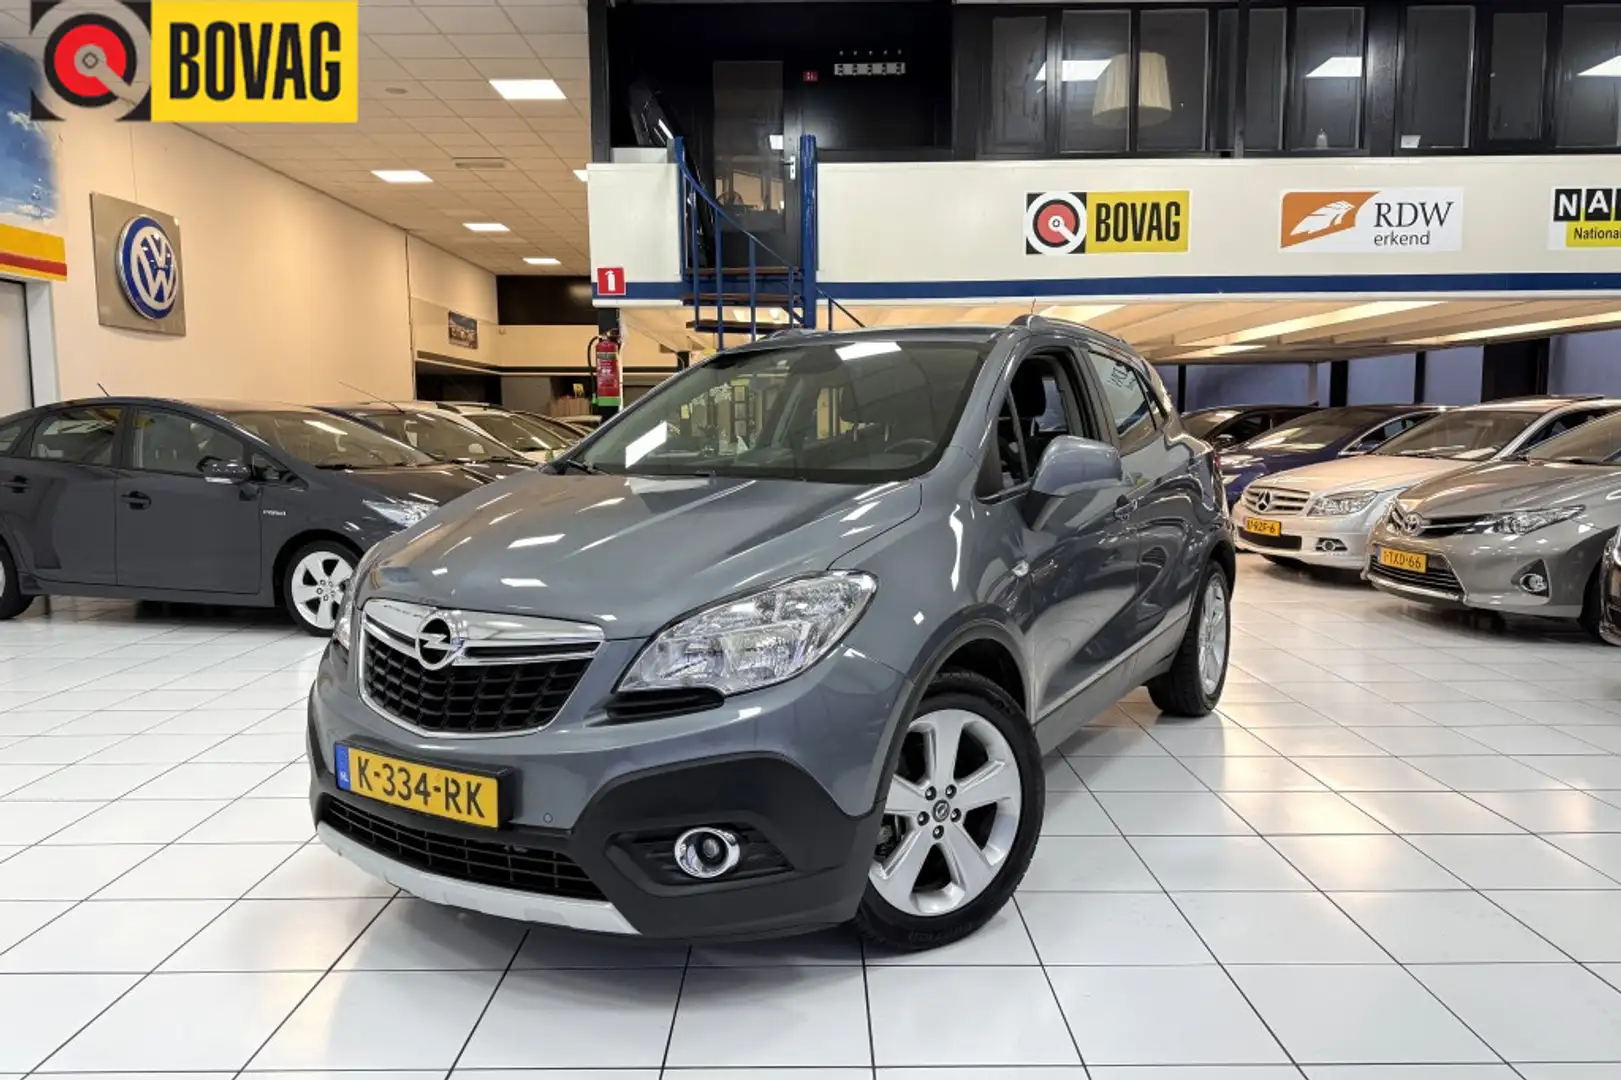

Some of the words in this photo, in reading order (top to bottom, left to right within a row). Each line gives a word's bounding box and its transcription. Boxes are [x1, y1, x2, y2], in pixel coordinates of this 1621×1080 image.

[1373, 201, 1454, 228] RDW
[1558, 190, 1616, 217] NA
[1095, 201, 1181, 242] BOVAG
[1373, 230, 1431, 246] erkend
[357, 755, 486, 819] K-334-RK
